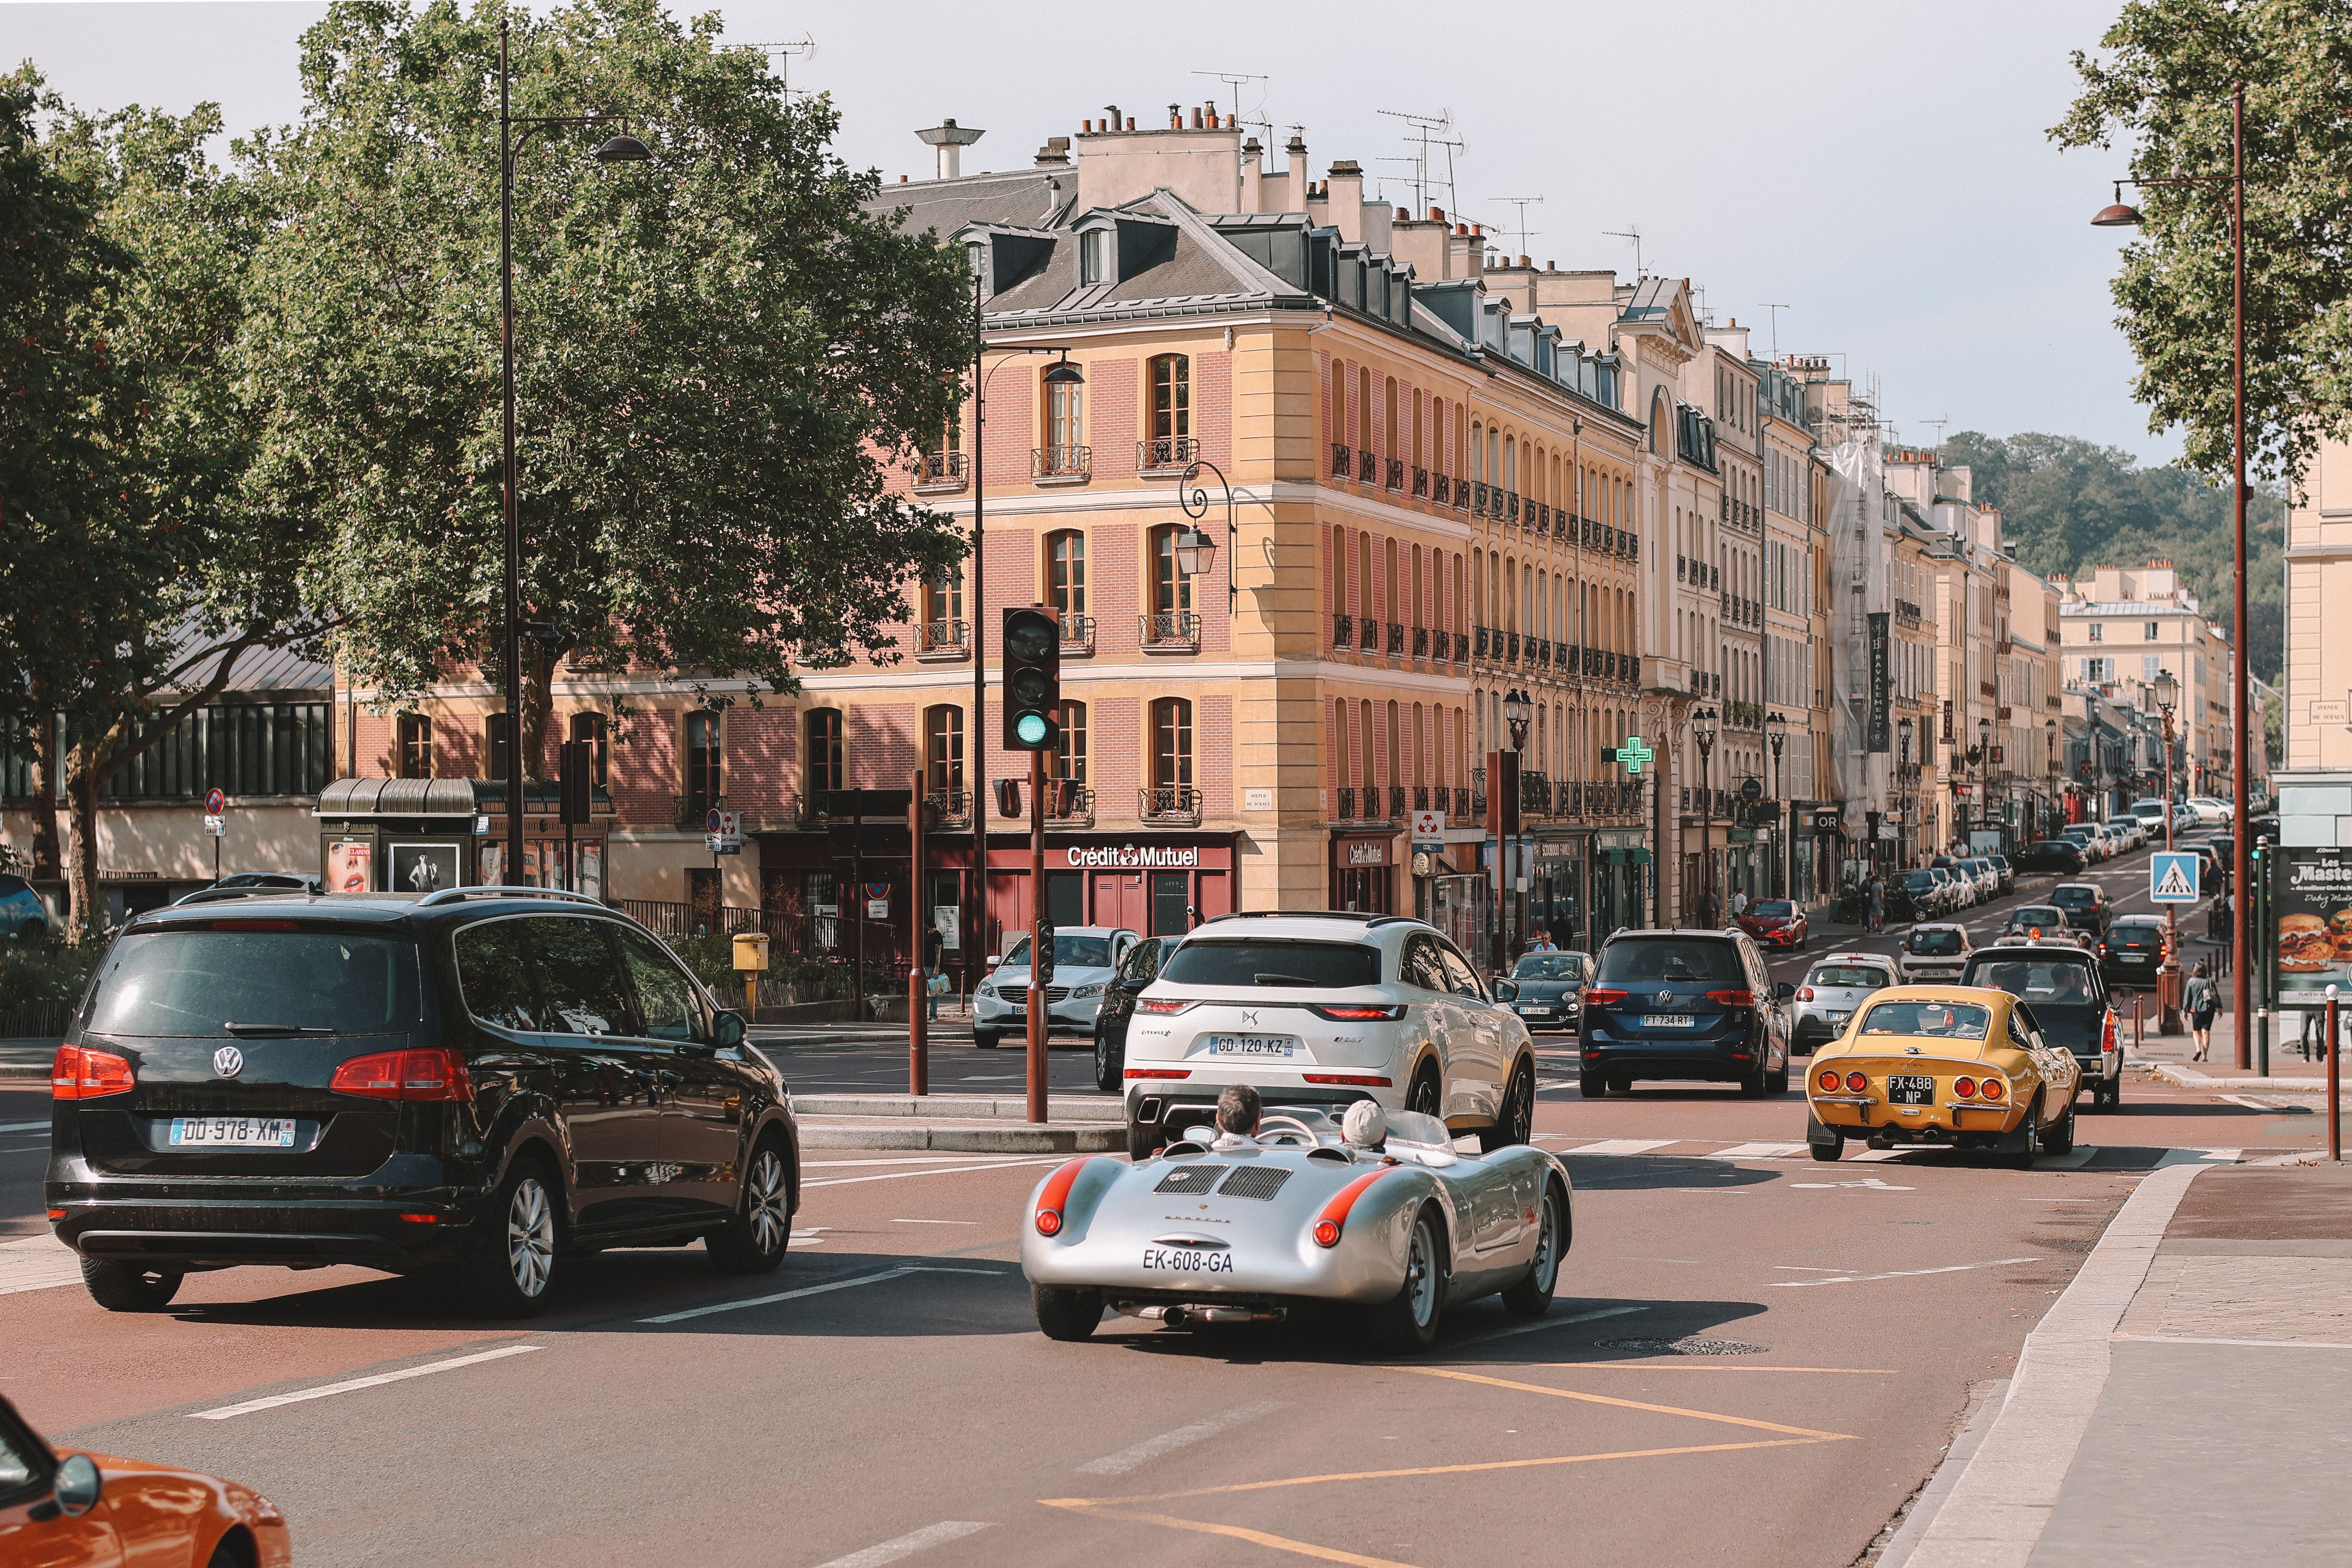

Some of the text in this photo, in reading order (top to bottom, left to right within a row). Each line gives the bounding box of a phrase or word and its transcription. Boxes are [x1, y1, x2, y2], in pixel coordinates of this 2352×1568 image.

[1874, 654, 1882, 728] RAVALEMENT
[1818, 817, 1837, 827] OR
[1067, 846, 1197, 866] Crédit Mutuel
[1350, 844, 1382, 864] Crédit Mutuel
[1560, 843, 1570, 855] FAMILY
[2321, 858, 2339, 867] Les
[2290, 866, 2352, 885] Maste
[1646, 1016, 1688, 1024] FT-734-RT
[1219, 1038, 1283, 1053] GD-120-KZ
[1889, 1076, 1932, 1089] FX-488
[184, 1121, 280, 1141] DD-978-XM
[1143, 1249, 1233, 1272] EK-608-GA
